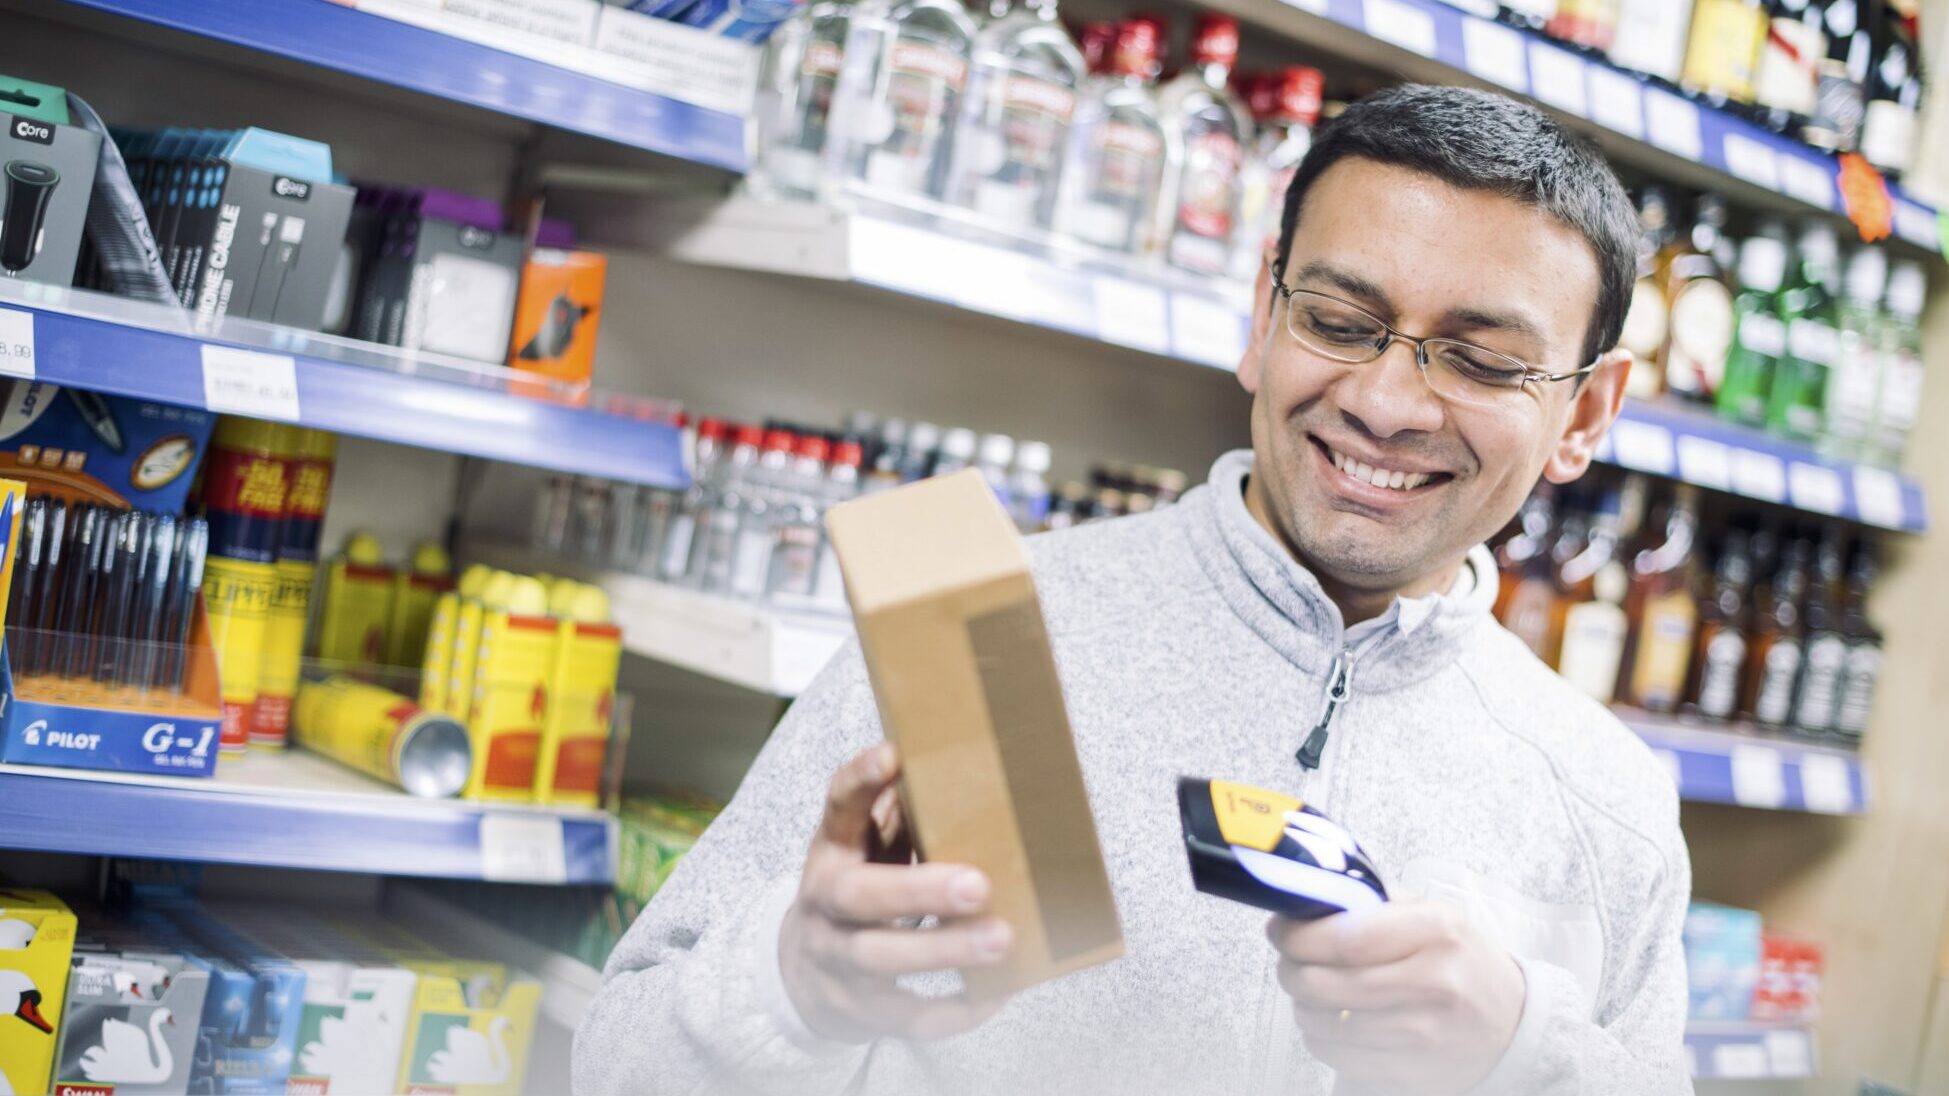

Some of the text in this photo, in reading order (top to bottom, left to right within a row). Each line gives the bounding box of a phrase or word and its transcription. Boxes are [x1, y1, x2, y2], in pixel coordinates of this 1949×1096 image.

[16, 121, 50, 140] Core
[46, 731, 101, 751] PILOT
[142, 722, 214, 757] G-1
